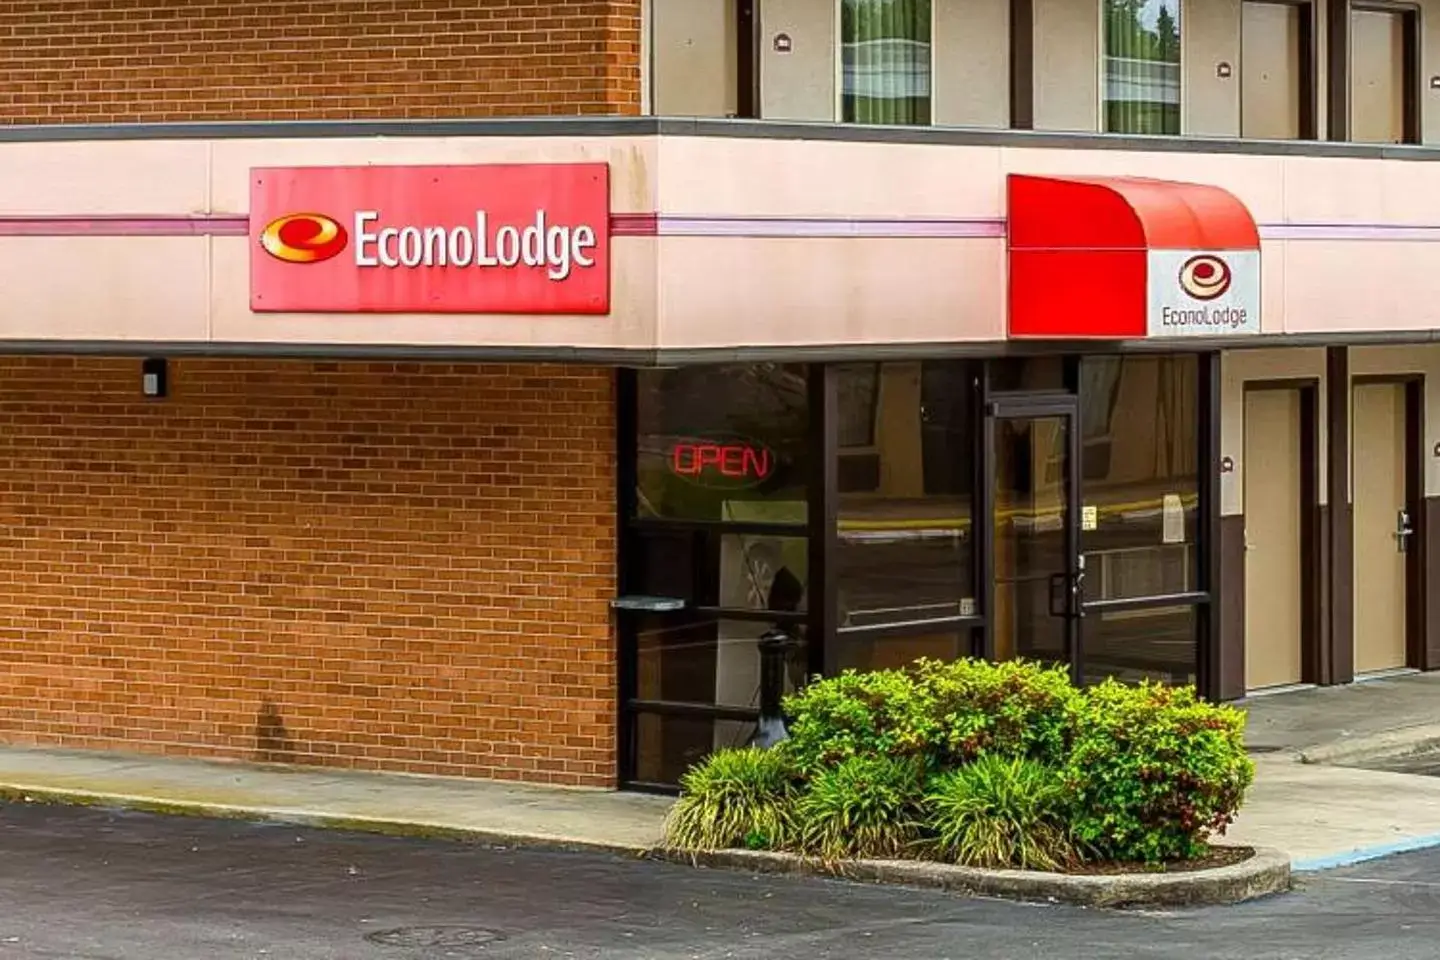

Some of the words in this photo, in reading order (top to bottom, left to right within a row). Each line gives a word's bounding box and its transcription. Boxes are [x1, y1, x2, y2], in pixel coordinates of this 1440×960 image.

[354, 209, 597, 280] EconoLodge
[1162, 306, 1247, 329] EconoLodge
[674, 444, 768, 477] OPEN
